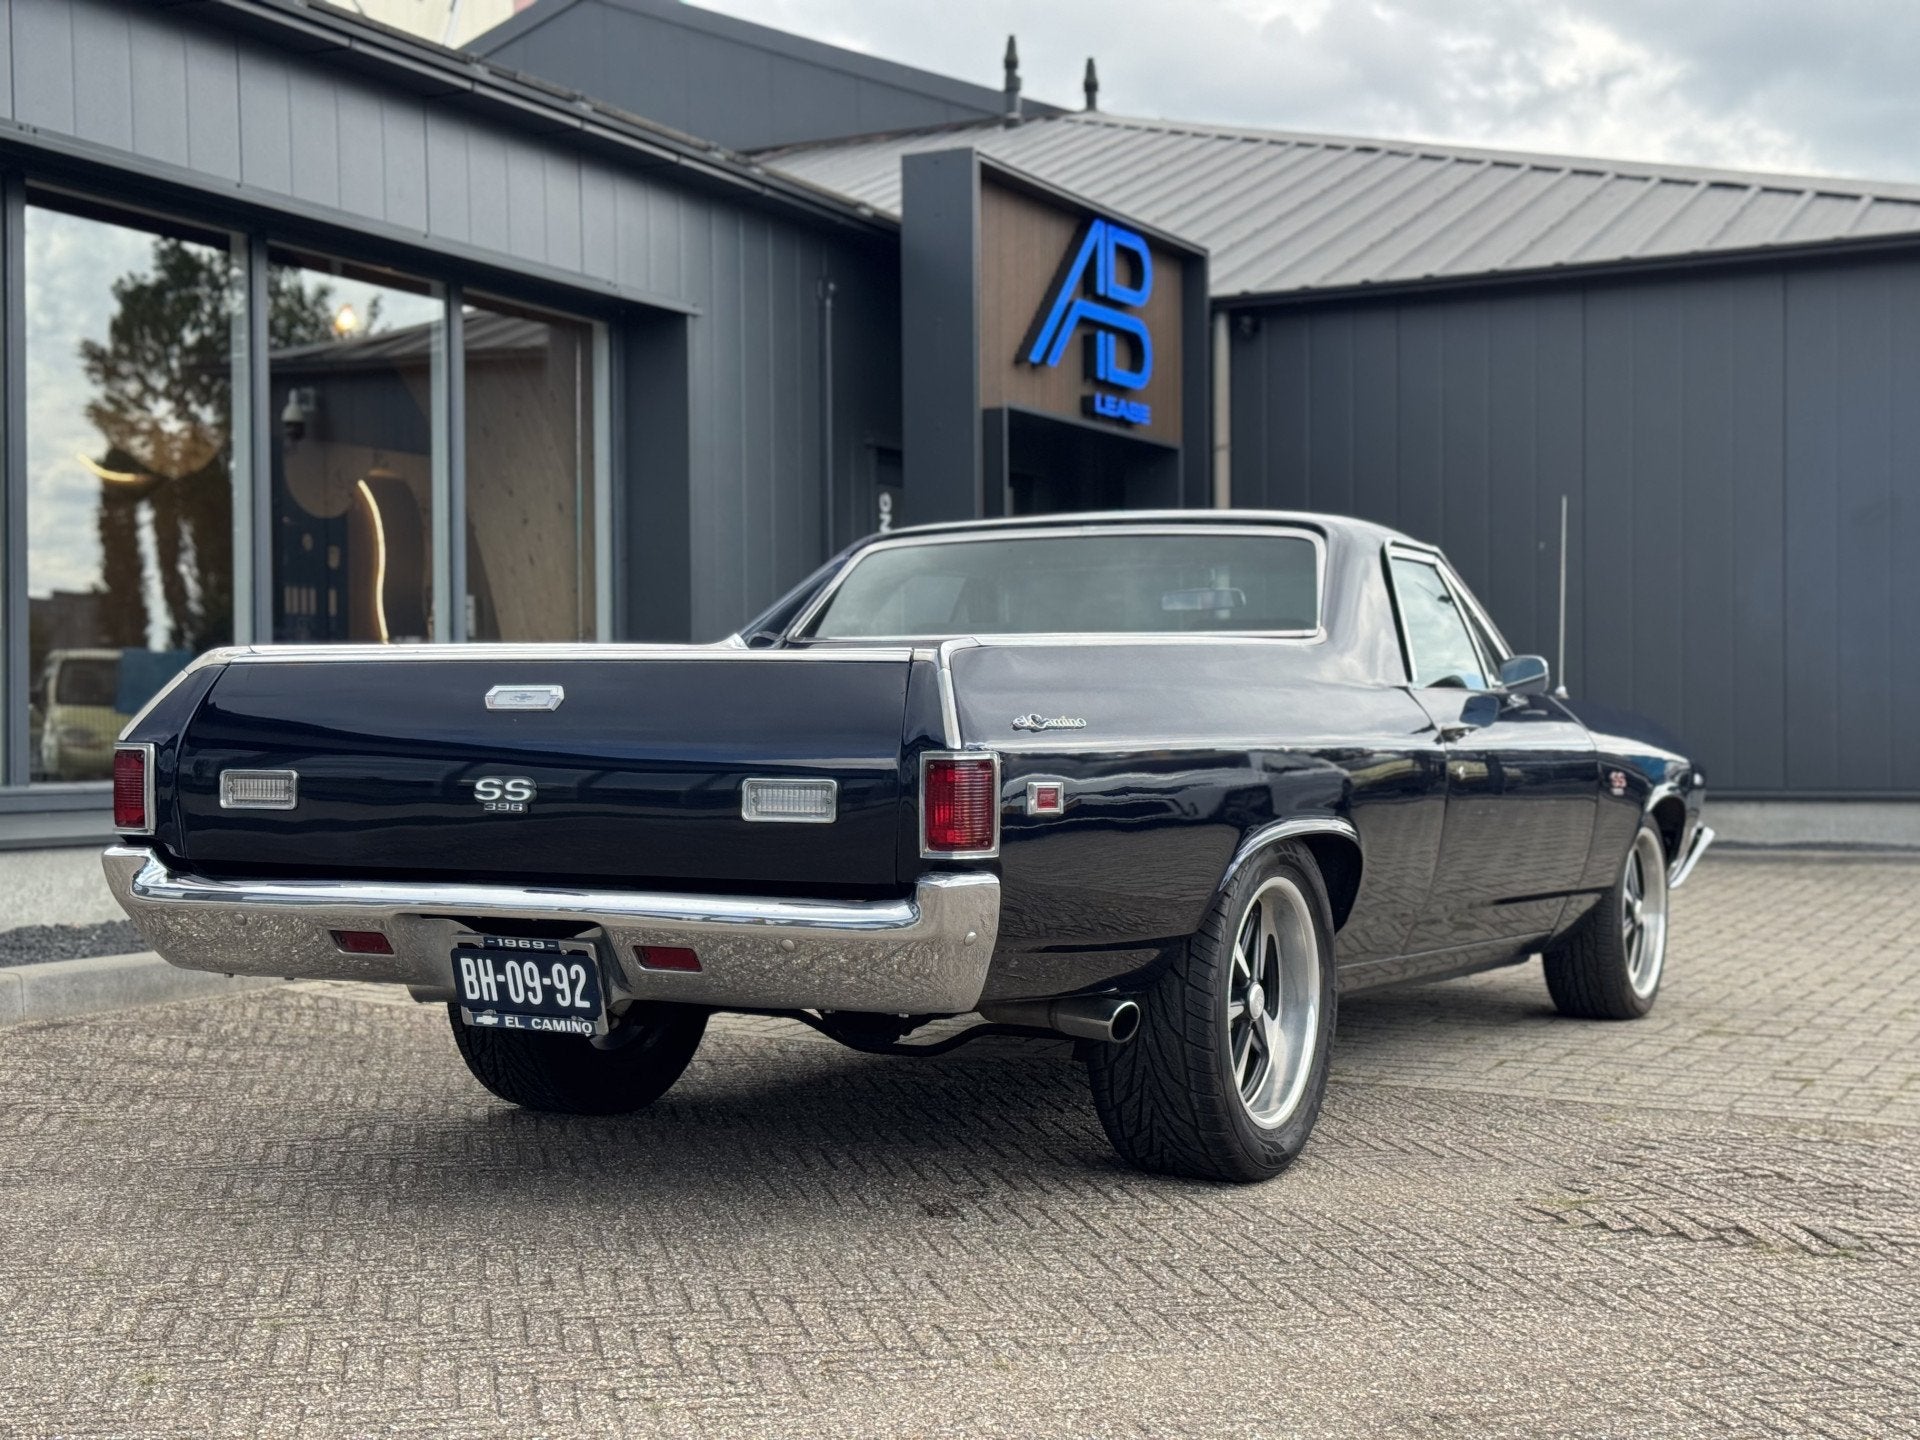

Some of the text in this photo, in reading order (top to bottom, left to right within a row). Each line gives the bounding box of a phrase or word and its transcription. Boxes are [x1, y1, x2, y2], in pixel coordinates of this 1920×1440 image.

[1094, 391, 1152, 426] LEASE
[474, 777, 533, 801] SS
[483, 802, 523, 812] 396
[460, 957, 591, 1009] BH-09-92
[504, 1015, 593, 1034] EL CAMINO
